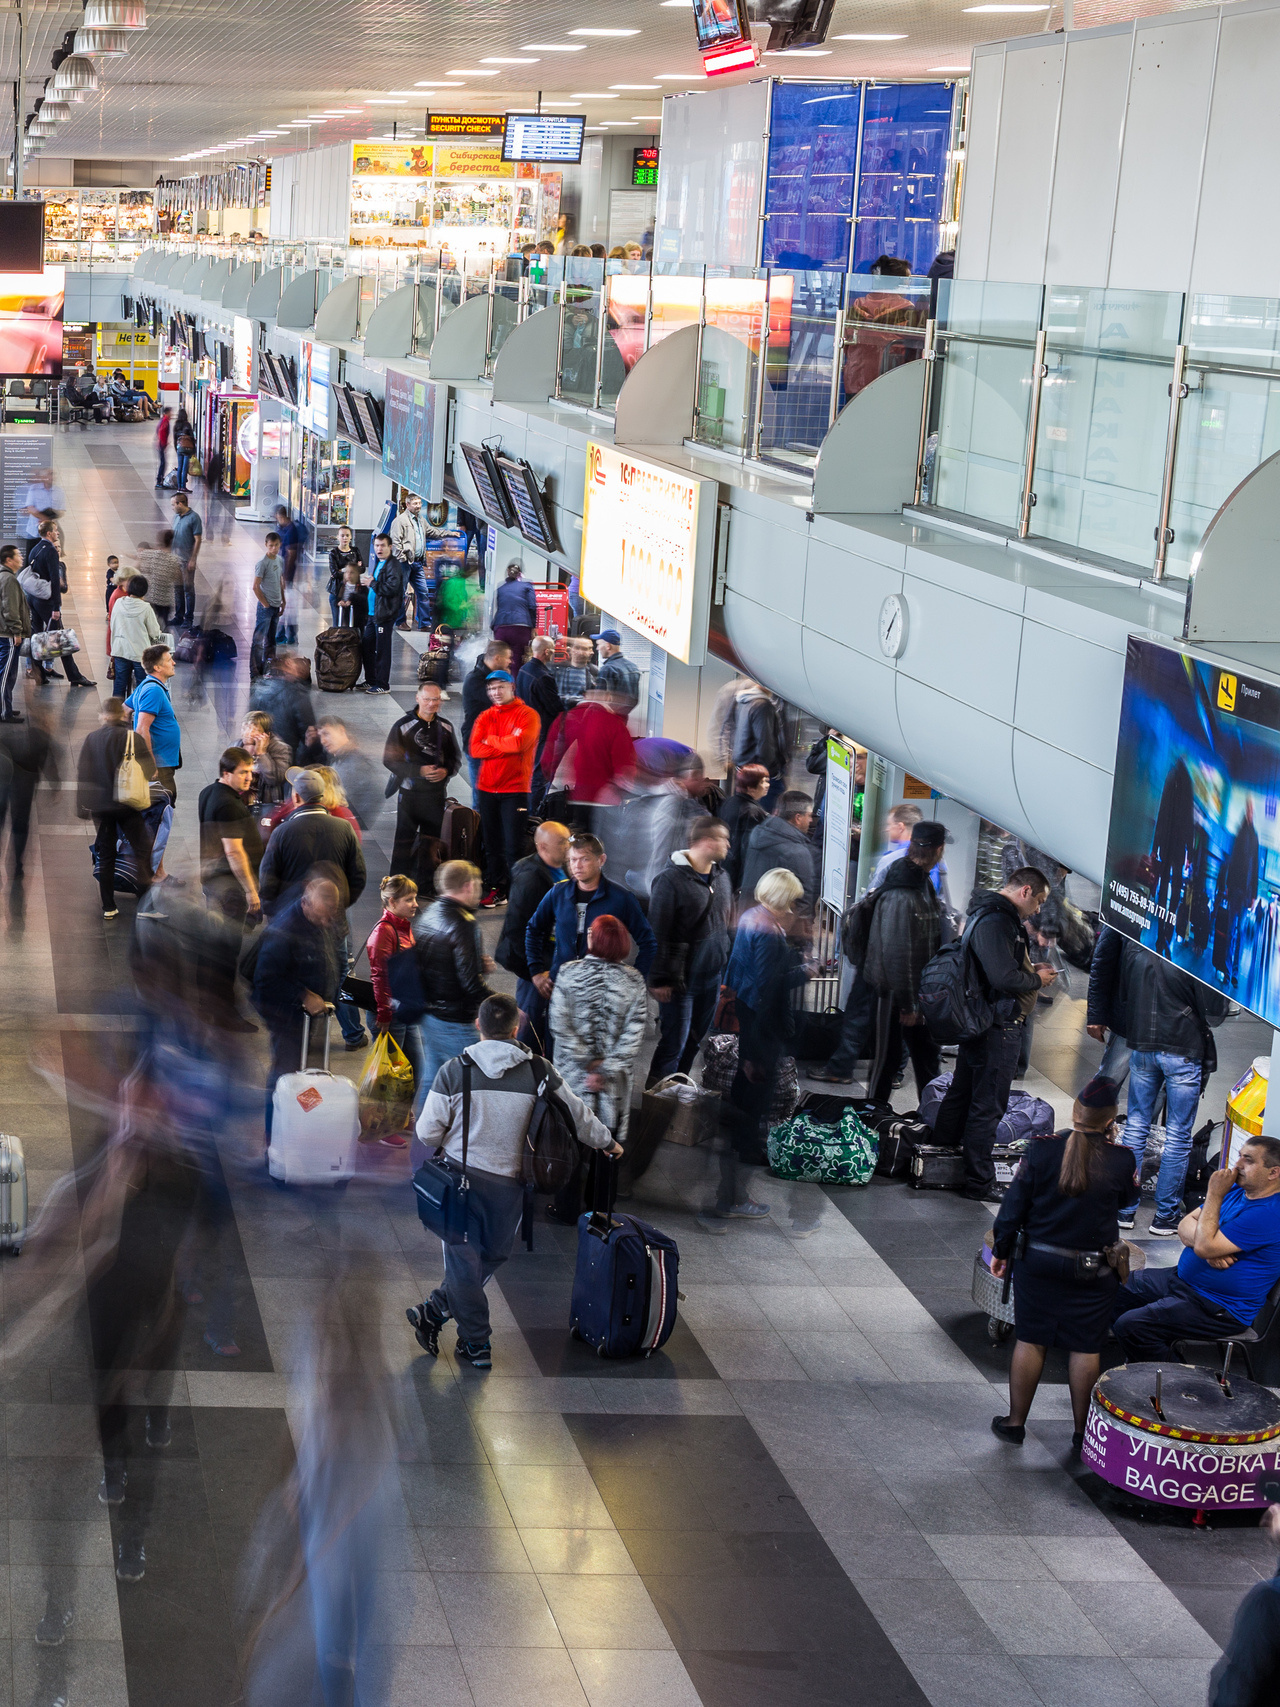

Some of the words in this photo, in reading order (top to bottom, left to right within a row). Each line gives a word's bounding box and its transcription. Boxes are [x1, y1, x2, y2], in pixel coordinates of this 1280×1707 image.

[431, 116, 460, 124] ПУНКТЫ
[461, 116, 501, 125] ДОСМОТРА
[430, 124, 465, 132] SECURITY
[466, 125, 492, 133] CHECK
[450, 151, 501, 160] Сибирская
[449, 161, 500, 173] береста
[118, 333, 146, 343] Hertz
[1240, 683, 1261, 700] Прилет
[1109, 880, 1117, 892] +7
[1116, 882, 1129, 902] (495)
[1129, 889, 1155, 914] 755-89-76
[1158, 905, 1166, 919] 77
[1169, 910, 1177, 926] 78
[1110, 898, 1151, 930] www.amsgroup.ru
[1129, 1432, 1266, 1474] УПАКОВКА
[1125, 1465, 1256, 1504] BAGGAGE
